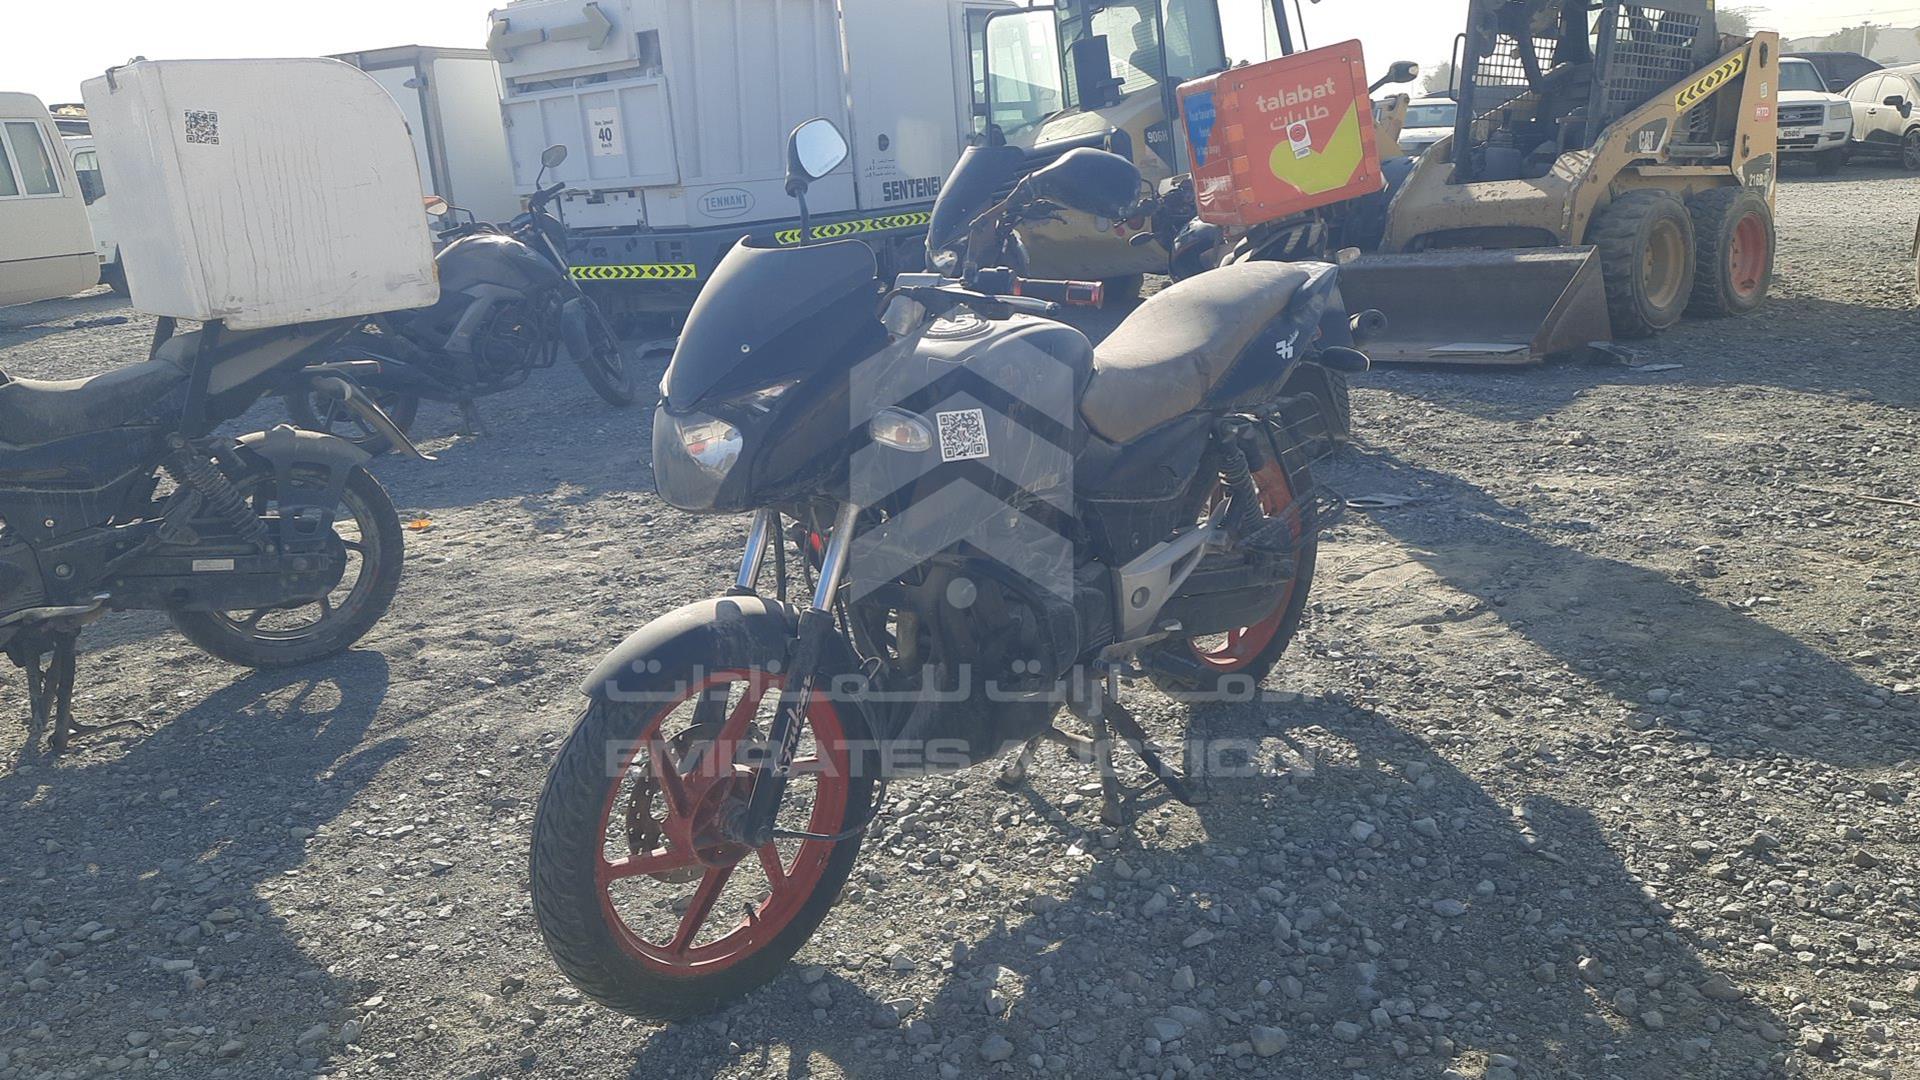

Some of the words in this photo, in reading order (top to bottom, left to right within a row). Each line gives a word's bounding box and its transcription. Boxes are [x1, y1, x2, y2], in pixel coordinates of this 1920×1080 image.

[1256, 77, 1336, 113] talabat
[599, 127, 612, 142] 40
[1639, 130, 1655, 150] CAT
[703, 192, 748, 212] TENNANT
